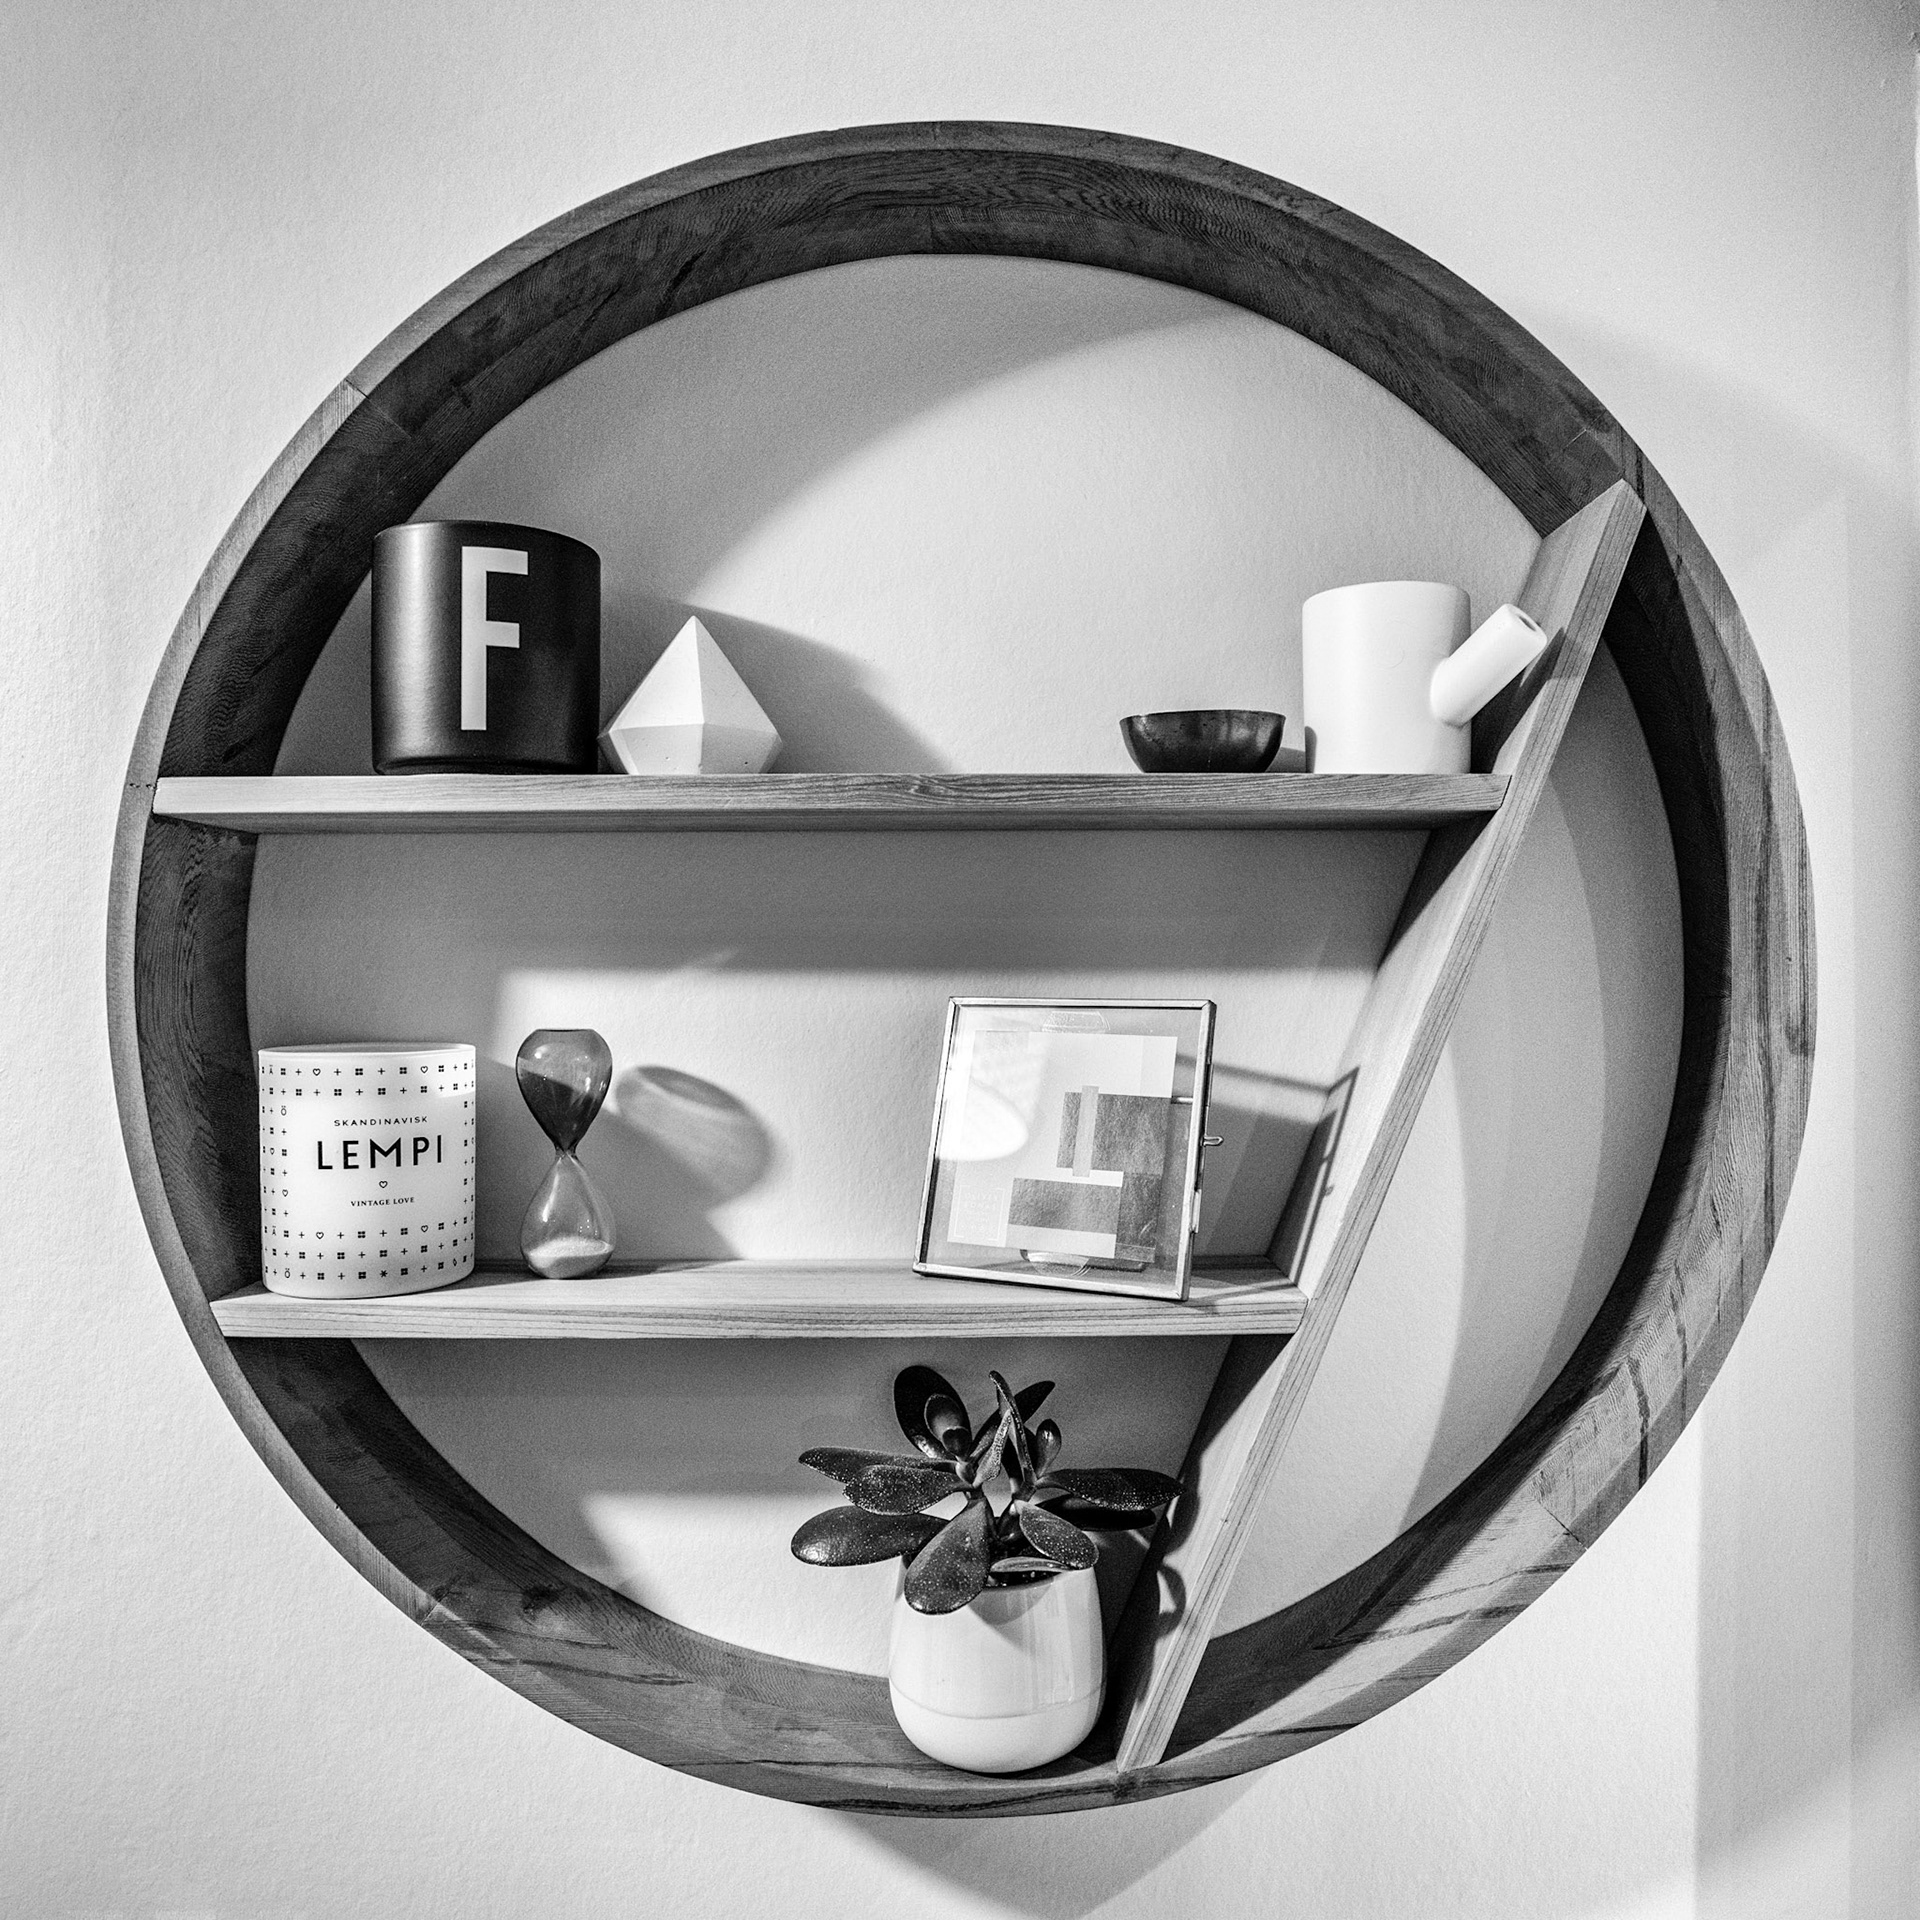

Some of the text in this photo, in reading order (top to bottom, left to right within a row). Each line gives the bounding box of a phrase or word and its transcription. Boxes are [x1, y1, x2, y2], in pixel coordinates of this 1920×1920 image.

[461, 546, 529, 731] F
[334, 1115, 428, 1127] SKANDINAVISK
[317, 1134, 442, 1170] LEMPI
[350, 1196, 415, 1207] VINTAGE LOVE
